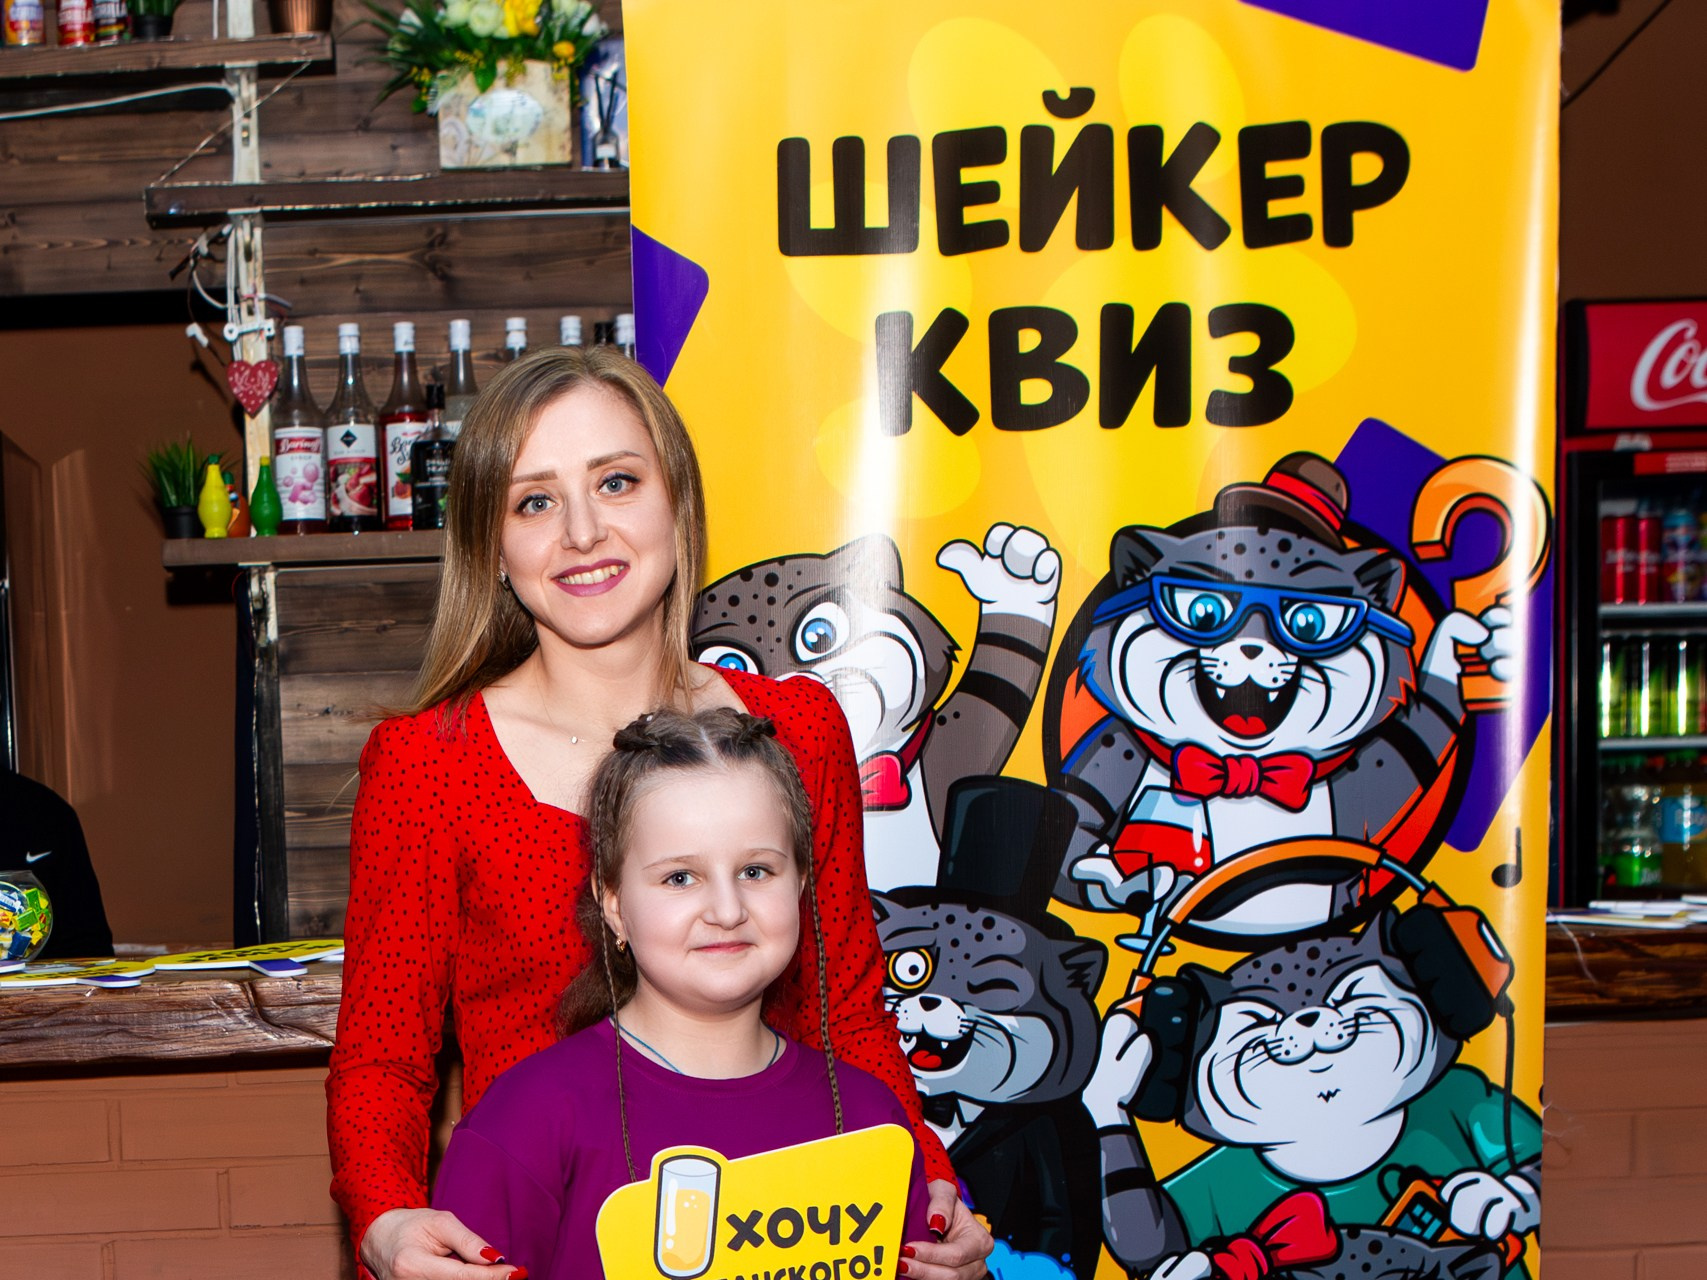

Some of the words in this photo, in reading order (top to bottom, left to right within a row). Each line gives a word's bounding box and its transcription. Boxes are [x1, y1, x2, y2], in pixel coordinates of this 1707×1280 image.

[777, 88, 1411, 257] ШЕЙКЕР
[875, 302, 1296, 437] КВИЗ
[726, 1202, 884, 1252] ХОЧУ
